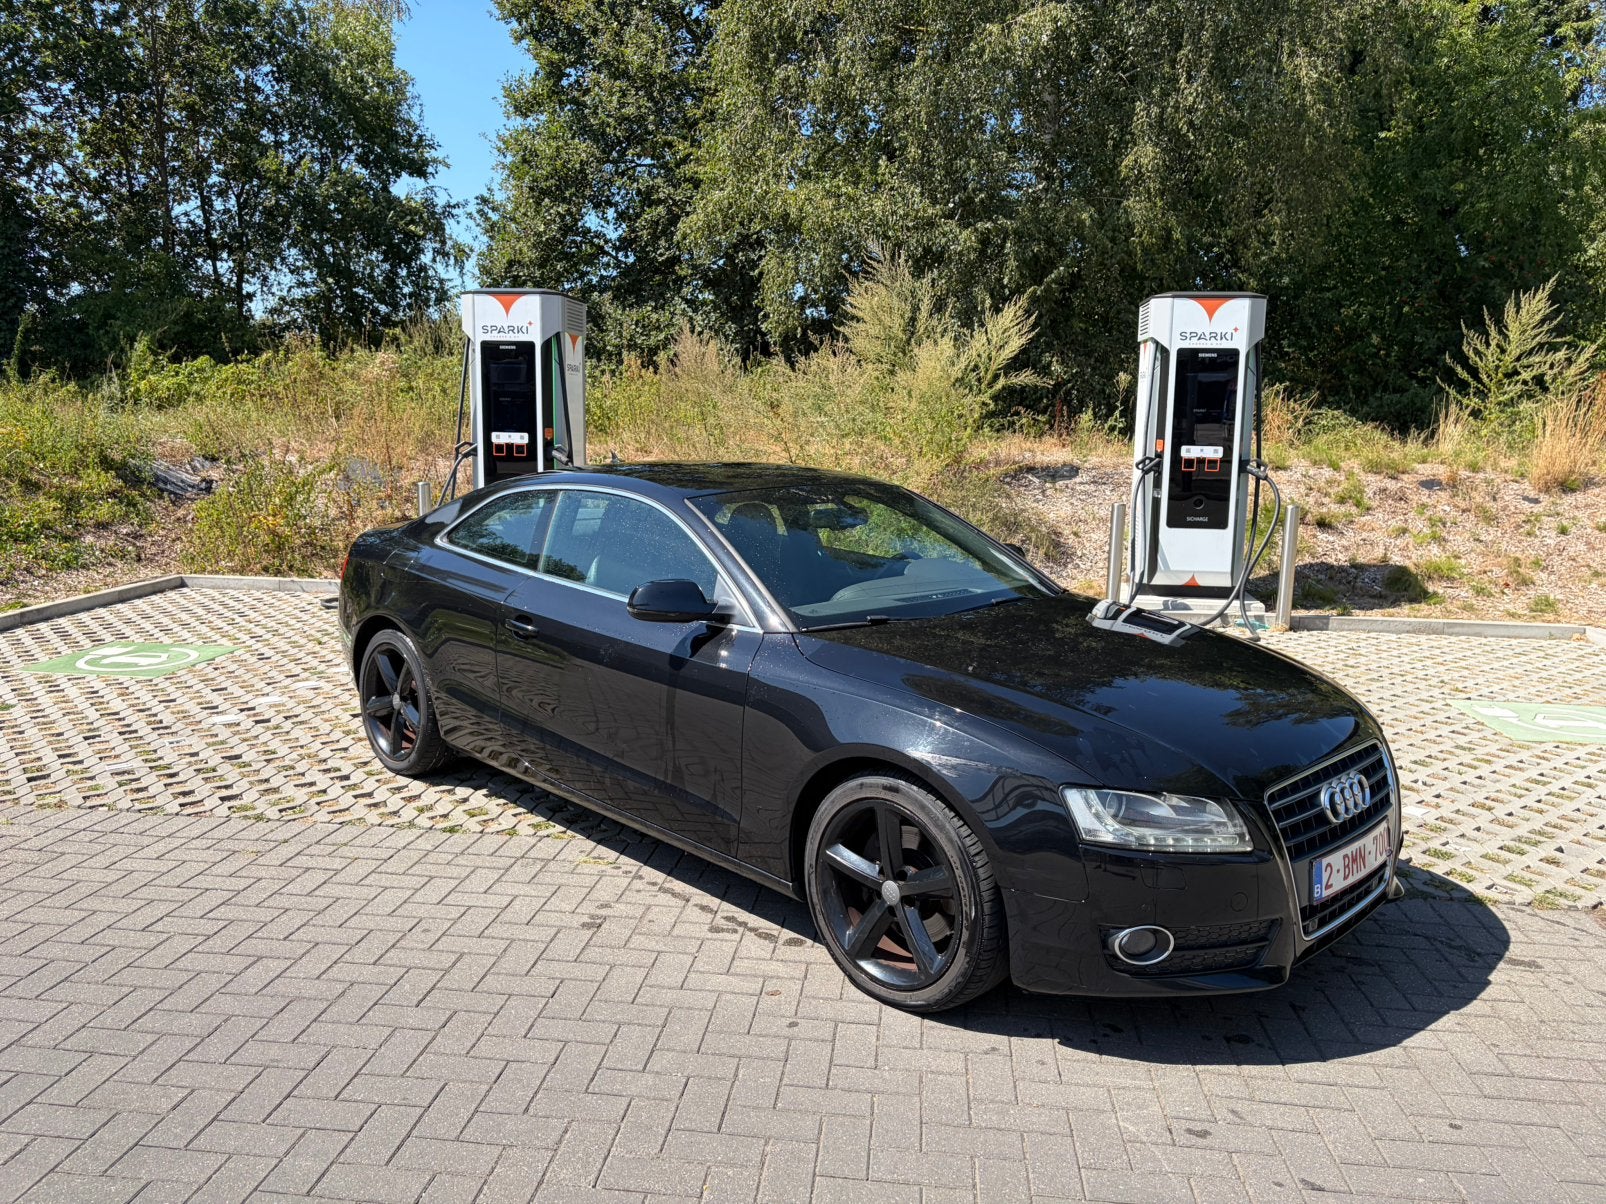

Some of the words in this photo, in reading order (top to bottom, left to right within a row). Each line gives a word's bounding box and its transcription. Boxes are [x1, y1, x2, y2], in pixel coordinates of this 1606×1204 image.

[482, 325, 528, 334] SPARKI
[1179, 331, 1233, 341] SPARKI
[1314, 884, 1321, 897] B
